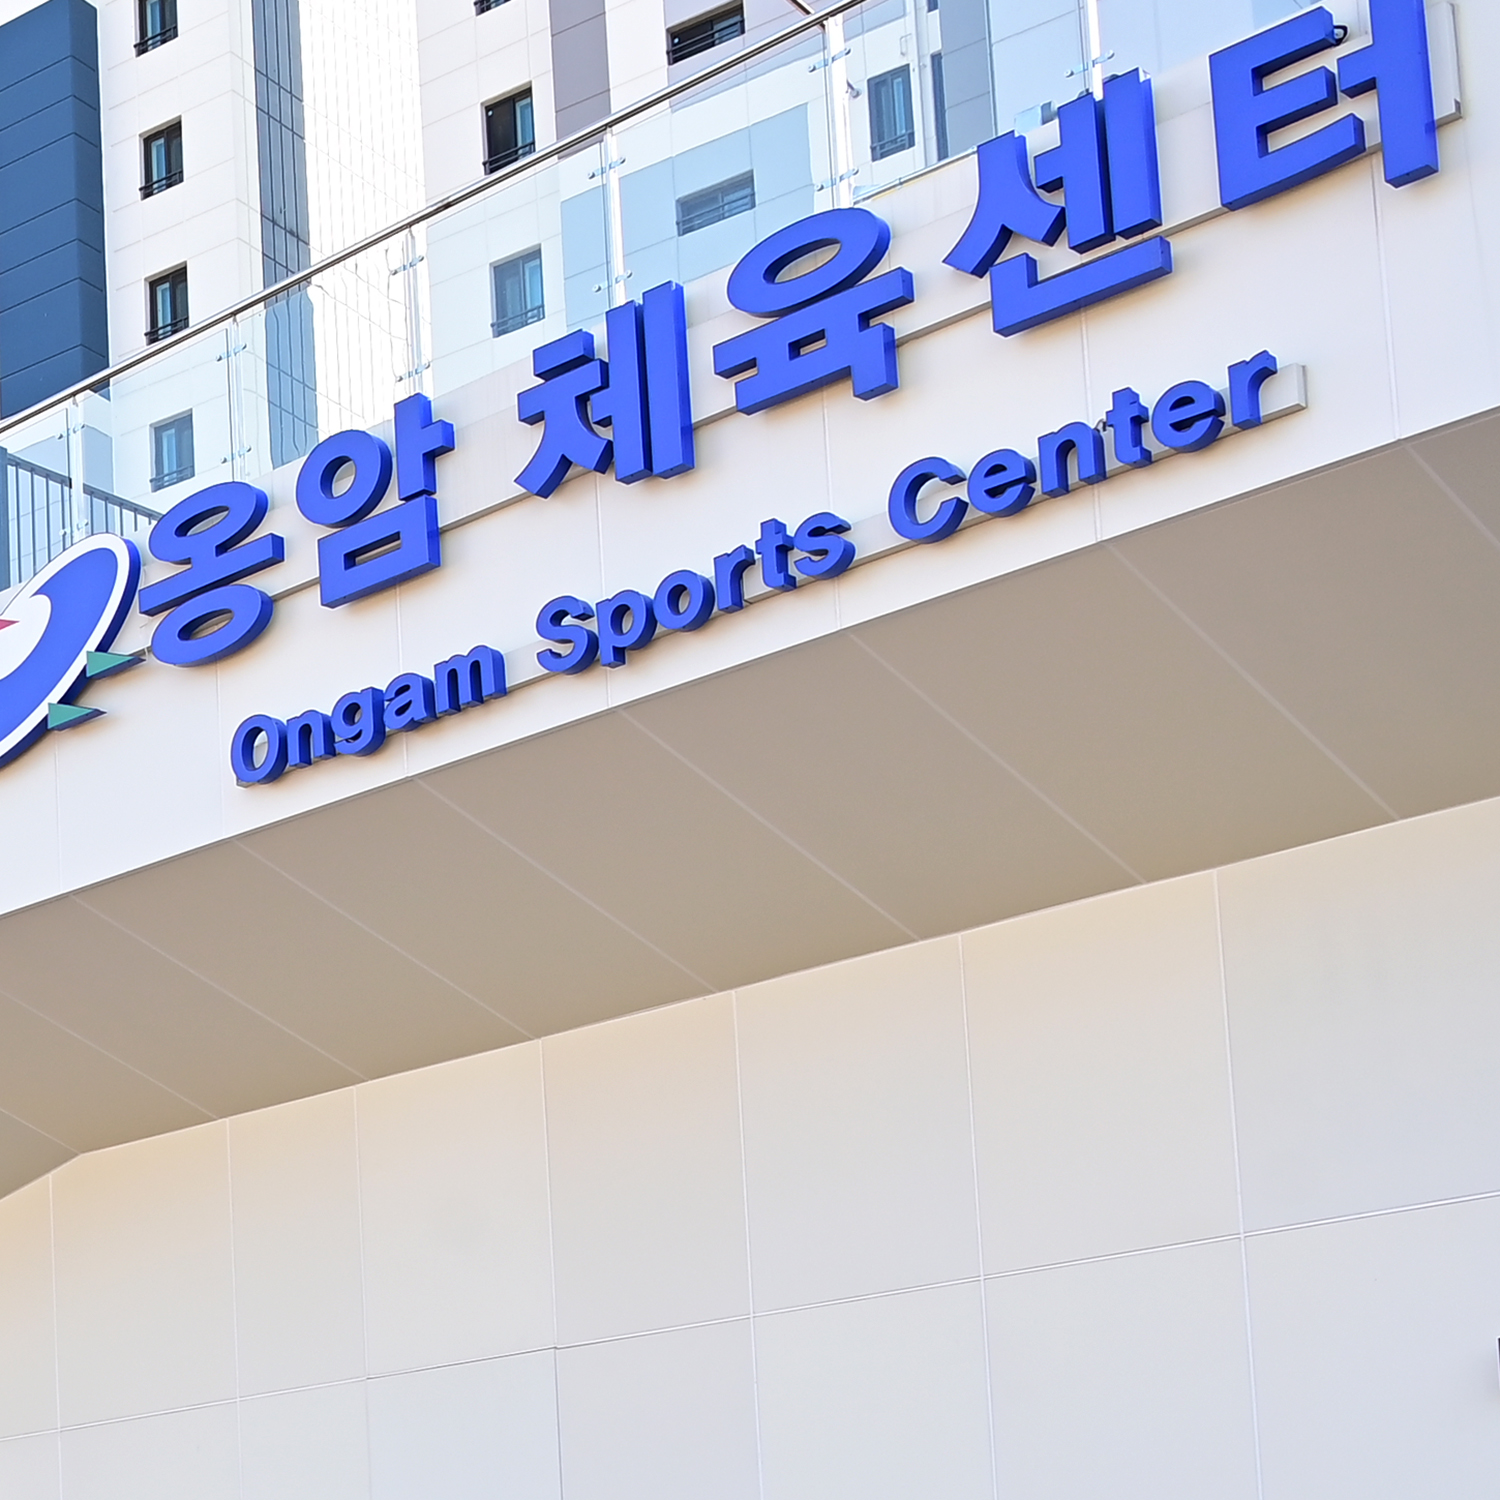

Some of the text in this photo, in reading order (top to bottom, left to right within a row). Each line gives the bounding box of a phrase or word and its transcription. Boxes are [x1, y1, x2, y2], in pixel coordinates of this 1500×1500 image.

[230, 350, 1279, 786] Ongam Sports Center
